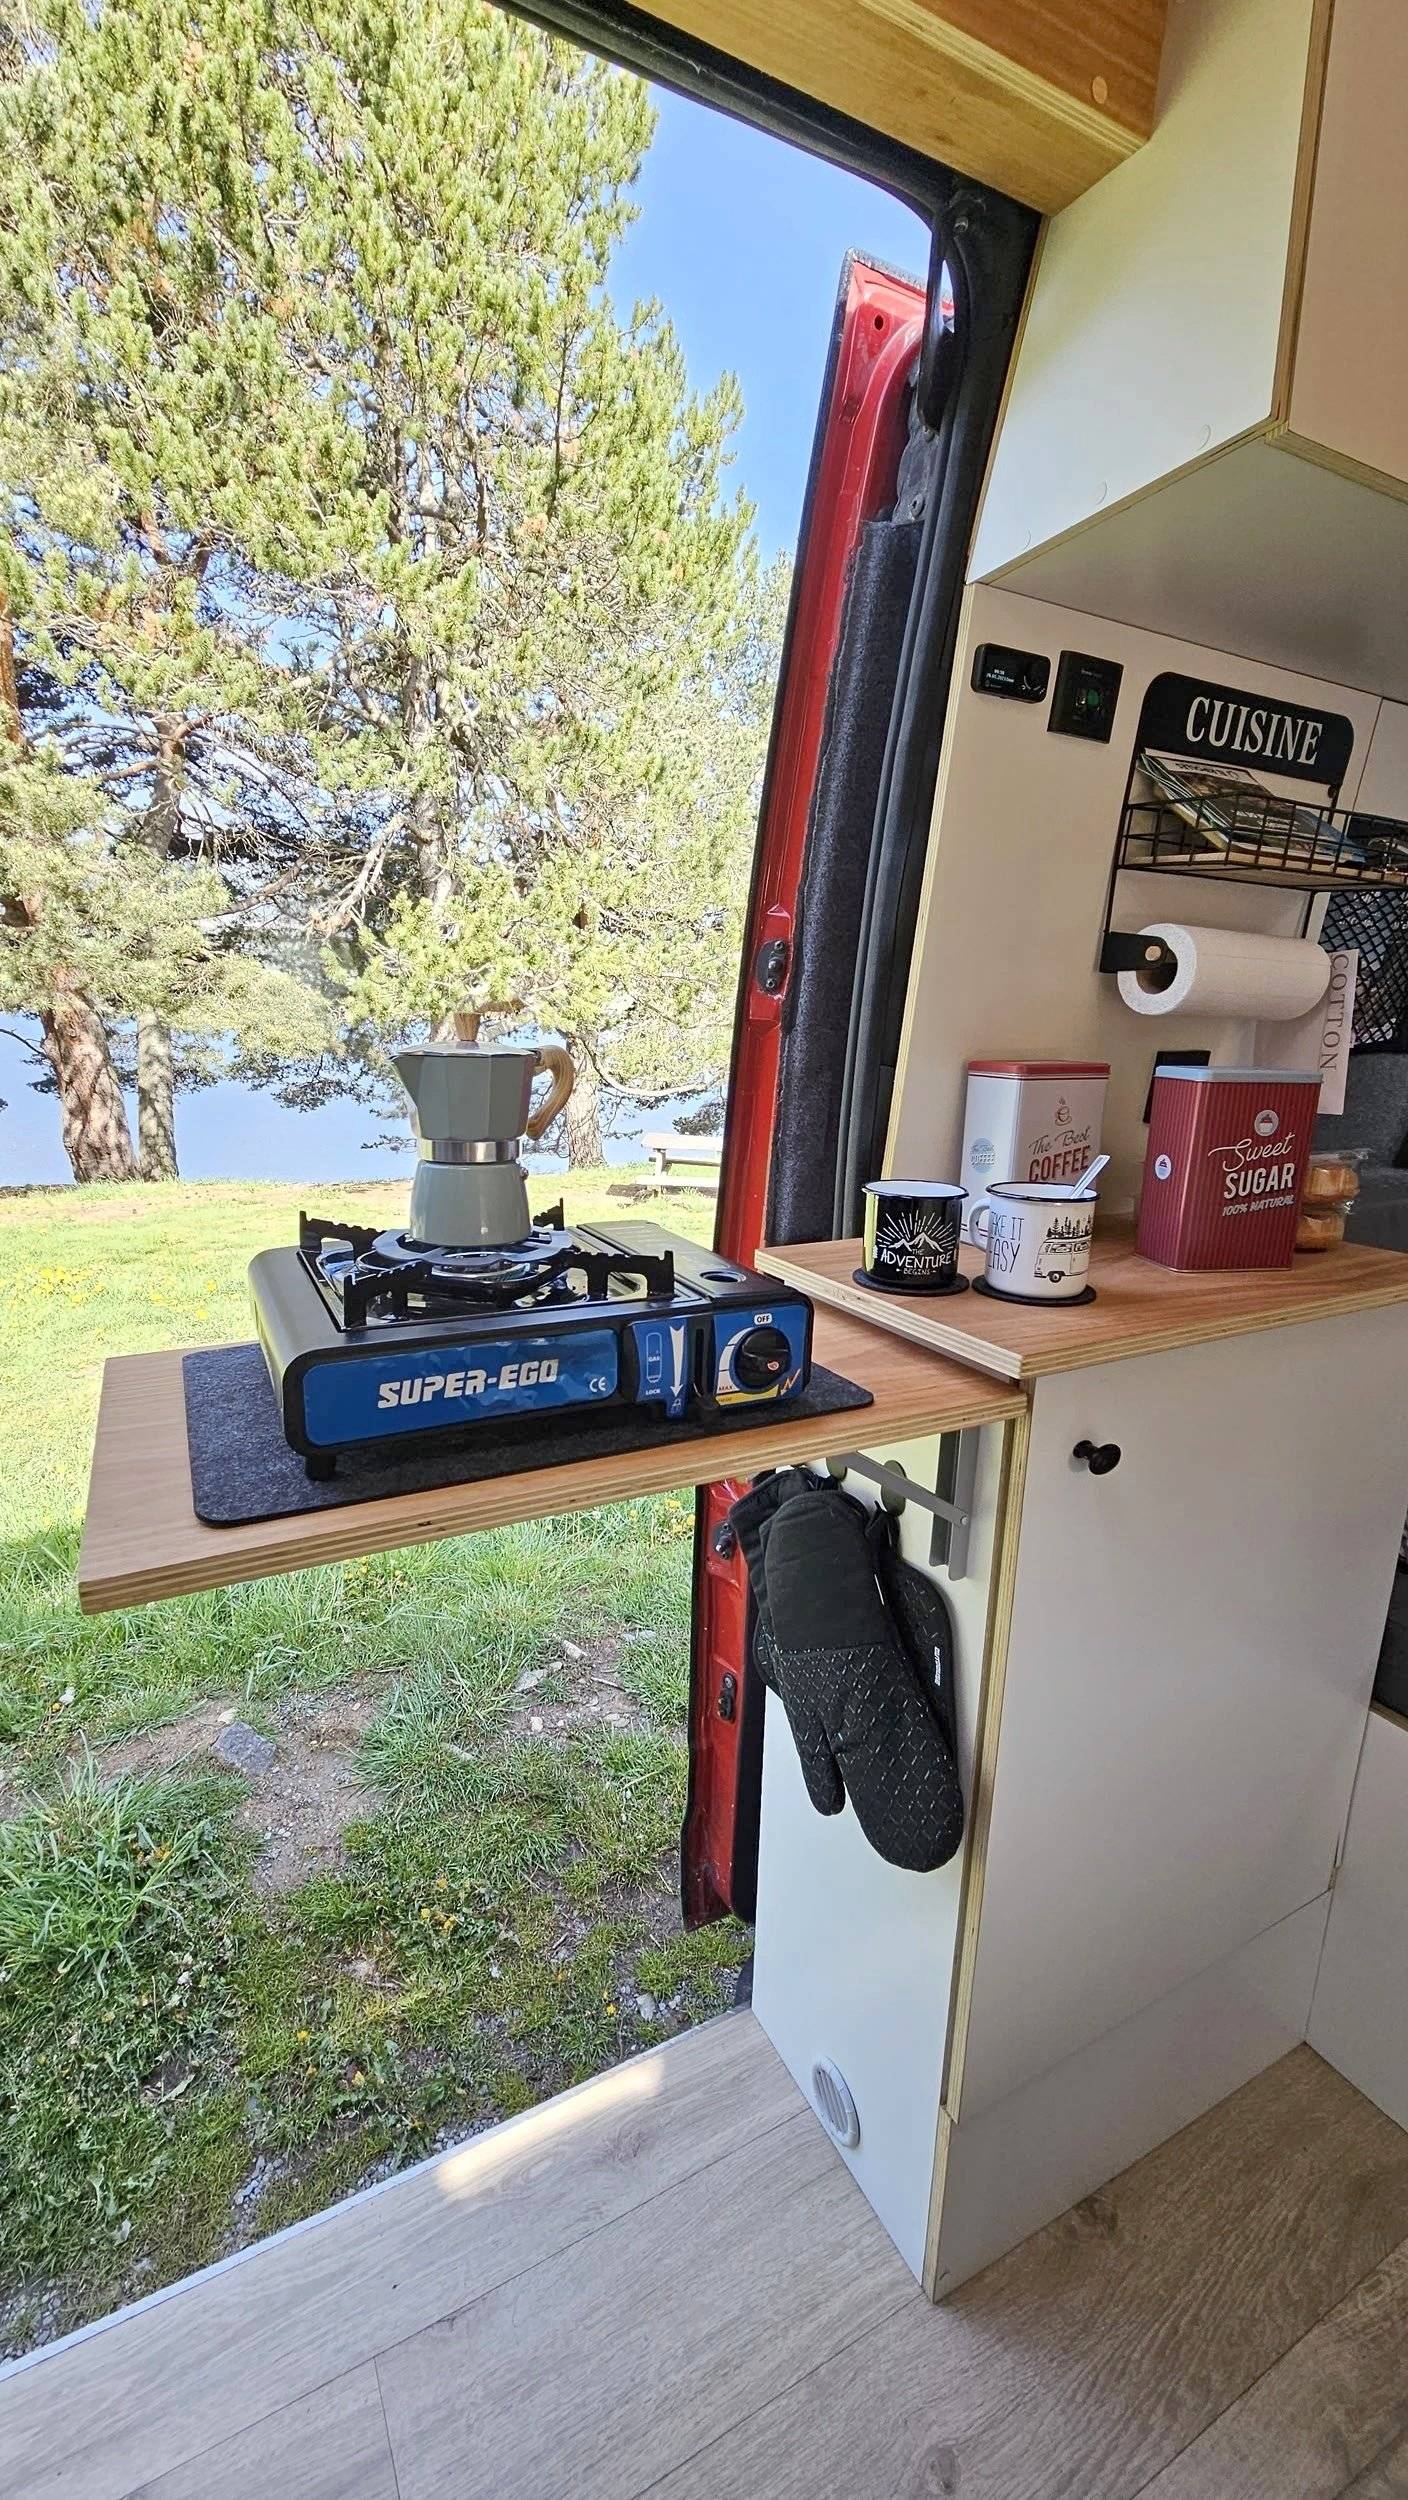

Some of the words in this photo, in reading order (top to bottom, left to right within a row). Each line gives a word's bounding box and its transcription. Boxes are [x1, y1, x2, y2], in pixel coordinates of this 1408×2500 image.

[1186, 696, 1324, 765] CUISINE
[1319, 953, 1350, 1071] COTTON
[1028, 1134, 1053, 1155] The
[1207, 1132, 1295, 1172] Sweet
[1028, 1144, 1091, 1183] COFFEE
[1223, 1162, 1295, 1199] SUGAR
[1222, 1203, 1248, 1217] 100%
[1249, 1194, 1295, 1212] NATURAL
[990, 1211, 1008, 1239] AKE
[1010, 1216, 1025, 1242] IT
[880, 1248, 953, 1269] ADVENTURE
[912, 1248, 925, 1256] THE
[903, 1267, 931, 1276] BEGINS
[756, 1315, 770, 1324] OFF
[377, 1358, 559, 1409] SUPER-EGO
[645, 1388, 661, 1396] LOCK
